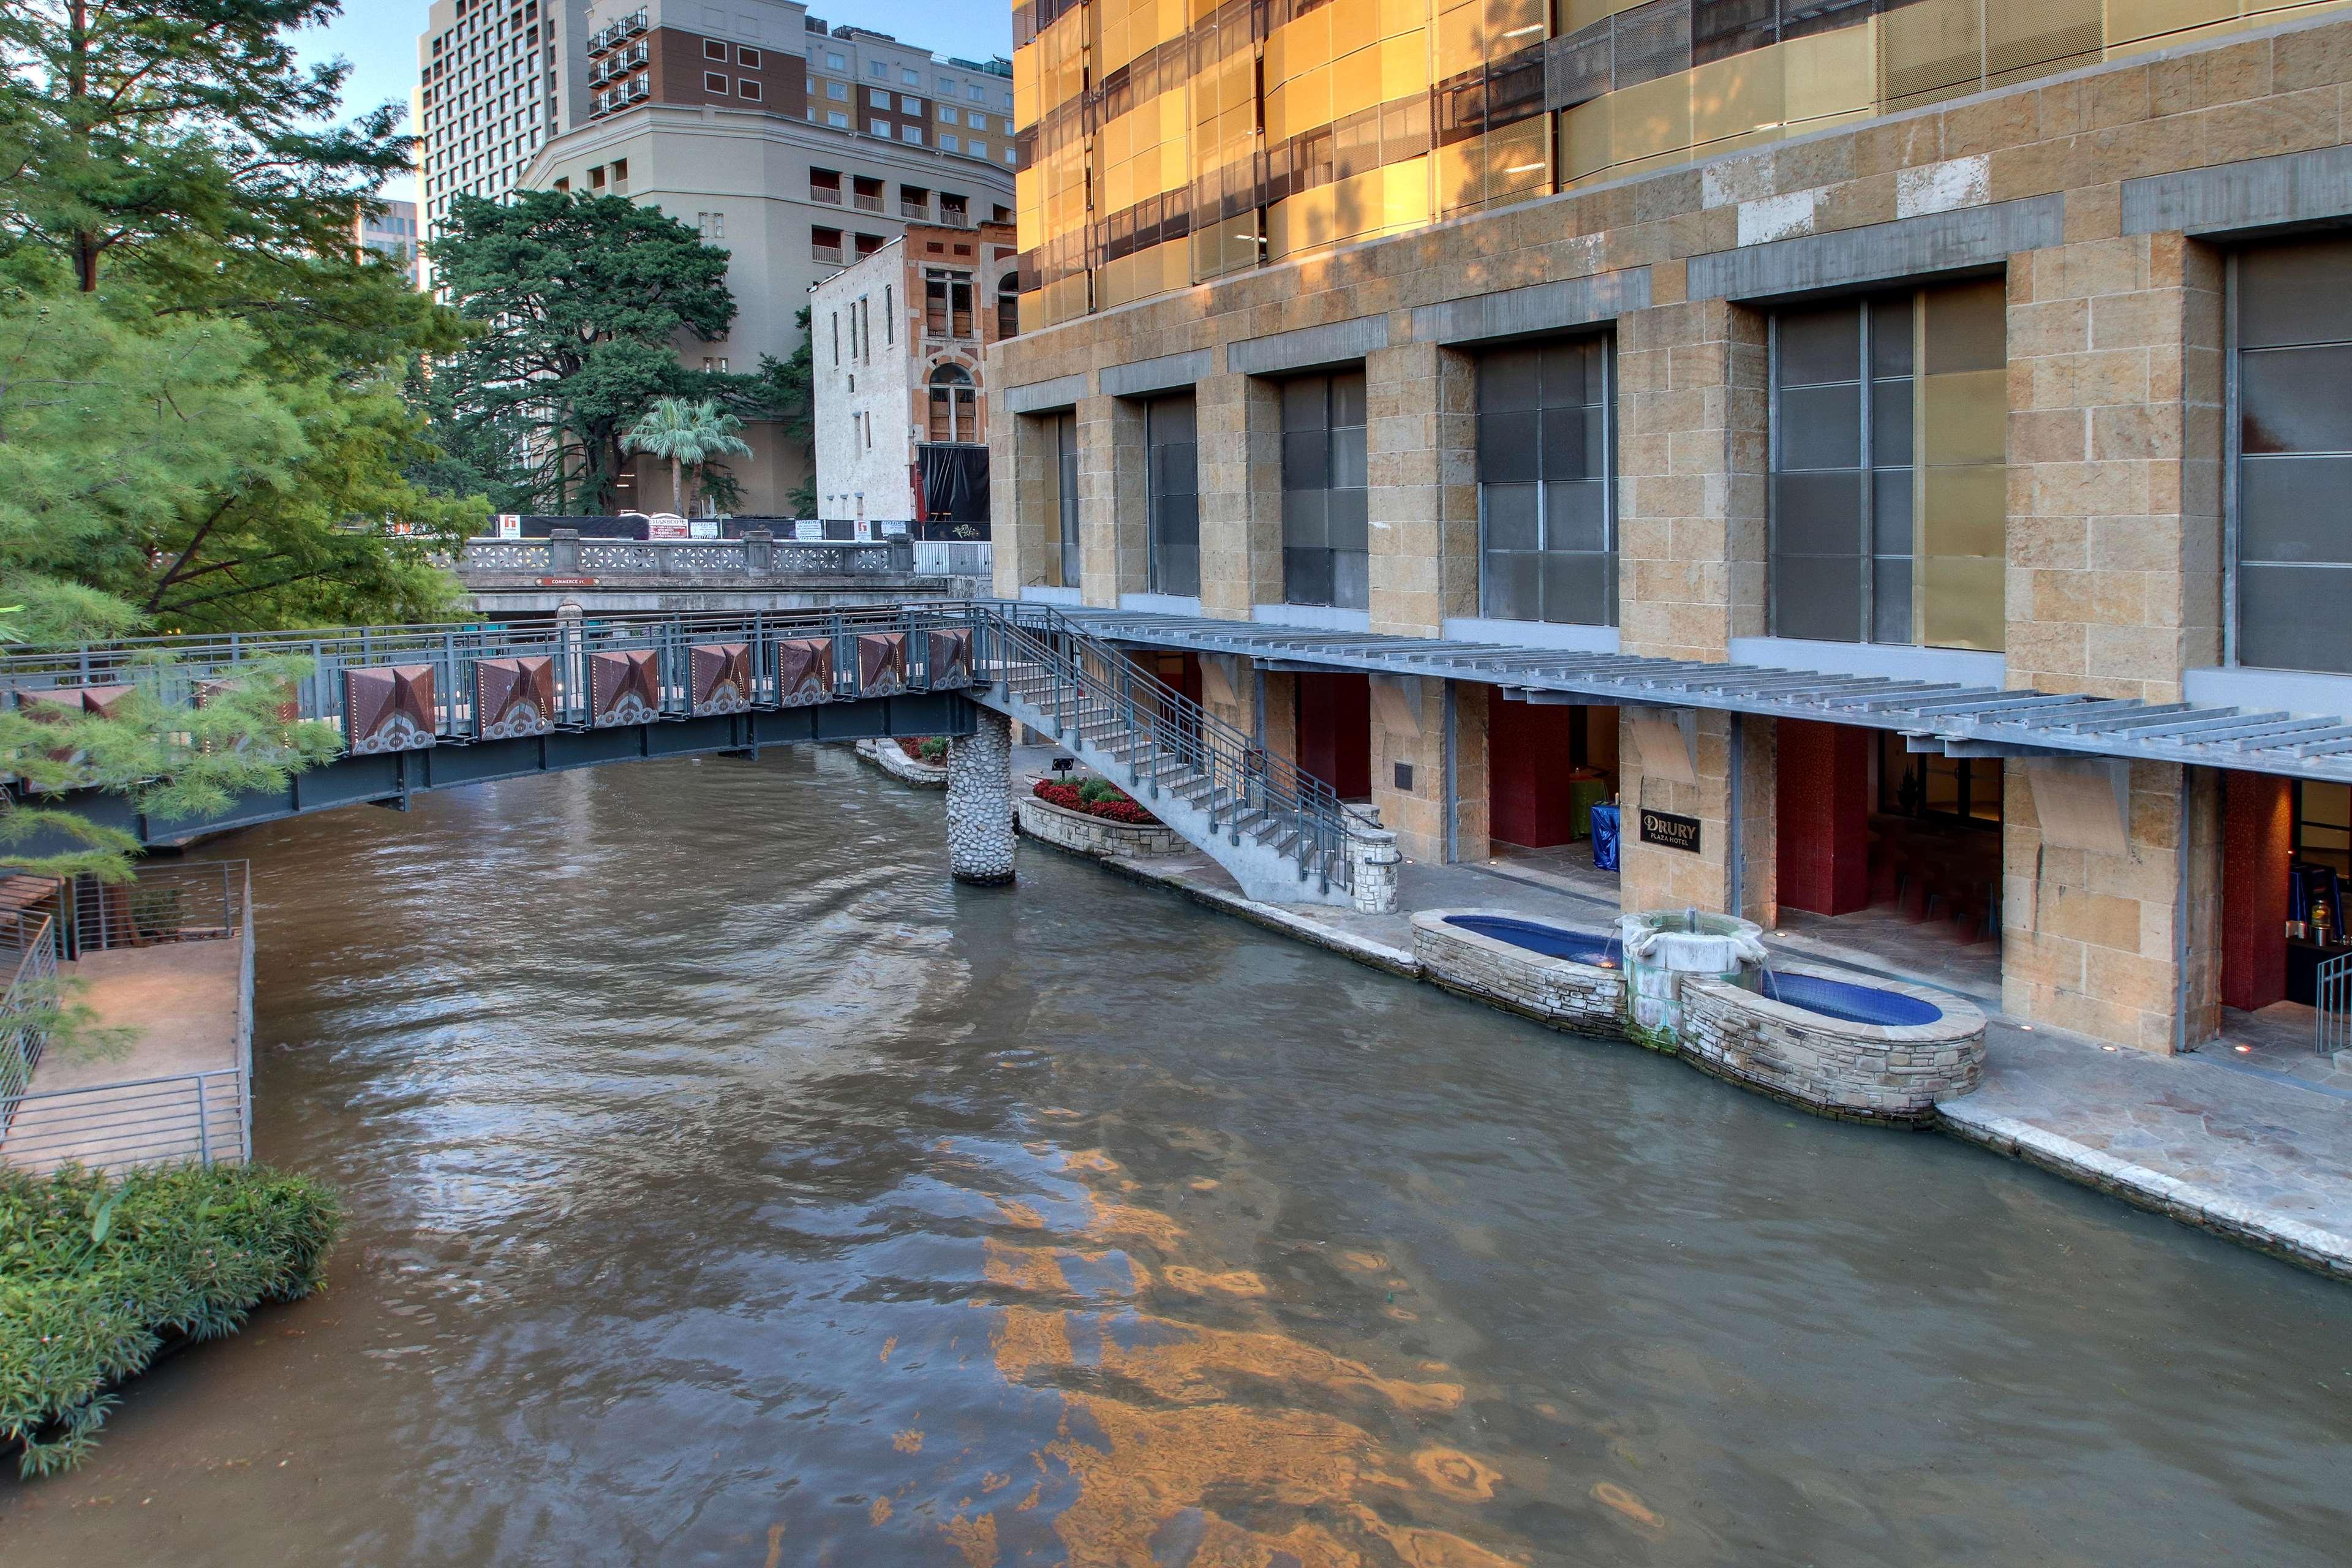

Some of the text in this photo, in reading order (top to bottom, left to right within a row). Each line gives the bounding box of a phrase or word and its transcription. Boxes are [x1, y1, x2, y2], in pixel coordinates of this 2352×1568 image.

[1644, 815, 1696, 840] DRURY
[1651, 833, 1689, 846] PLAZA HOTEL
